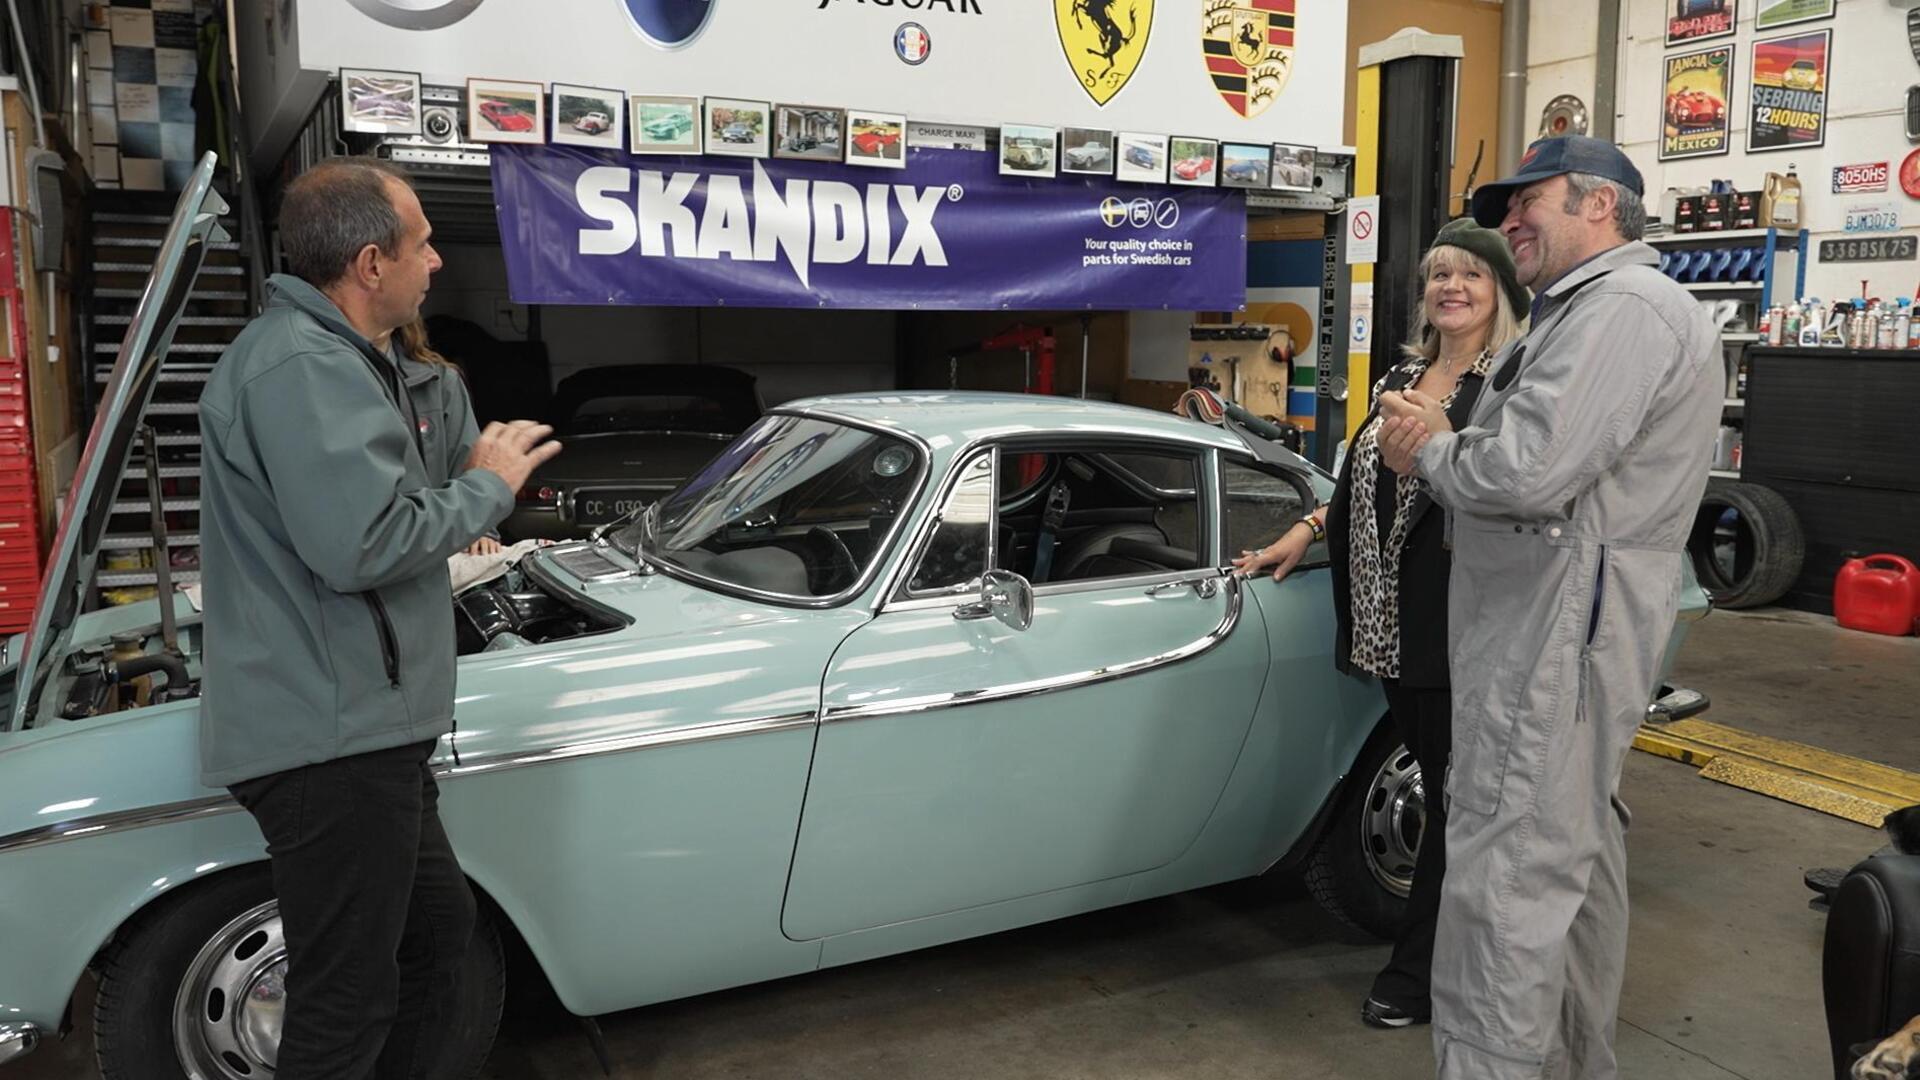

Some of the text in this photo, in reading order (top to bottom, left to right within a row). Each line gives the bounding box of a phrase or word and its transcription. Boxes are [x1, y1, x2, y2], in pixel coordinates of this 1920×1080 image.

[1669, 54, 1708, 76] LANCIA
[1752, 86, 1823, 113] SEBRING
[918, 127, 954, 138] CHARGE
[1665, 136, 1719, 152] MEXICO
[1837, 167, 1886, 185] 8050HS
[1085, 237, 1193, 253] Your quality choice in
[1083, 253, 1192, 267] parts for Swedish cars
